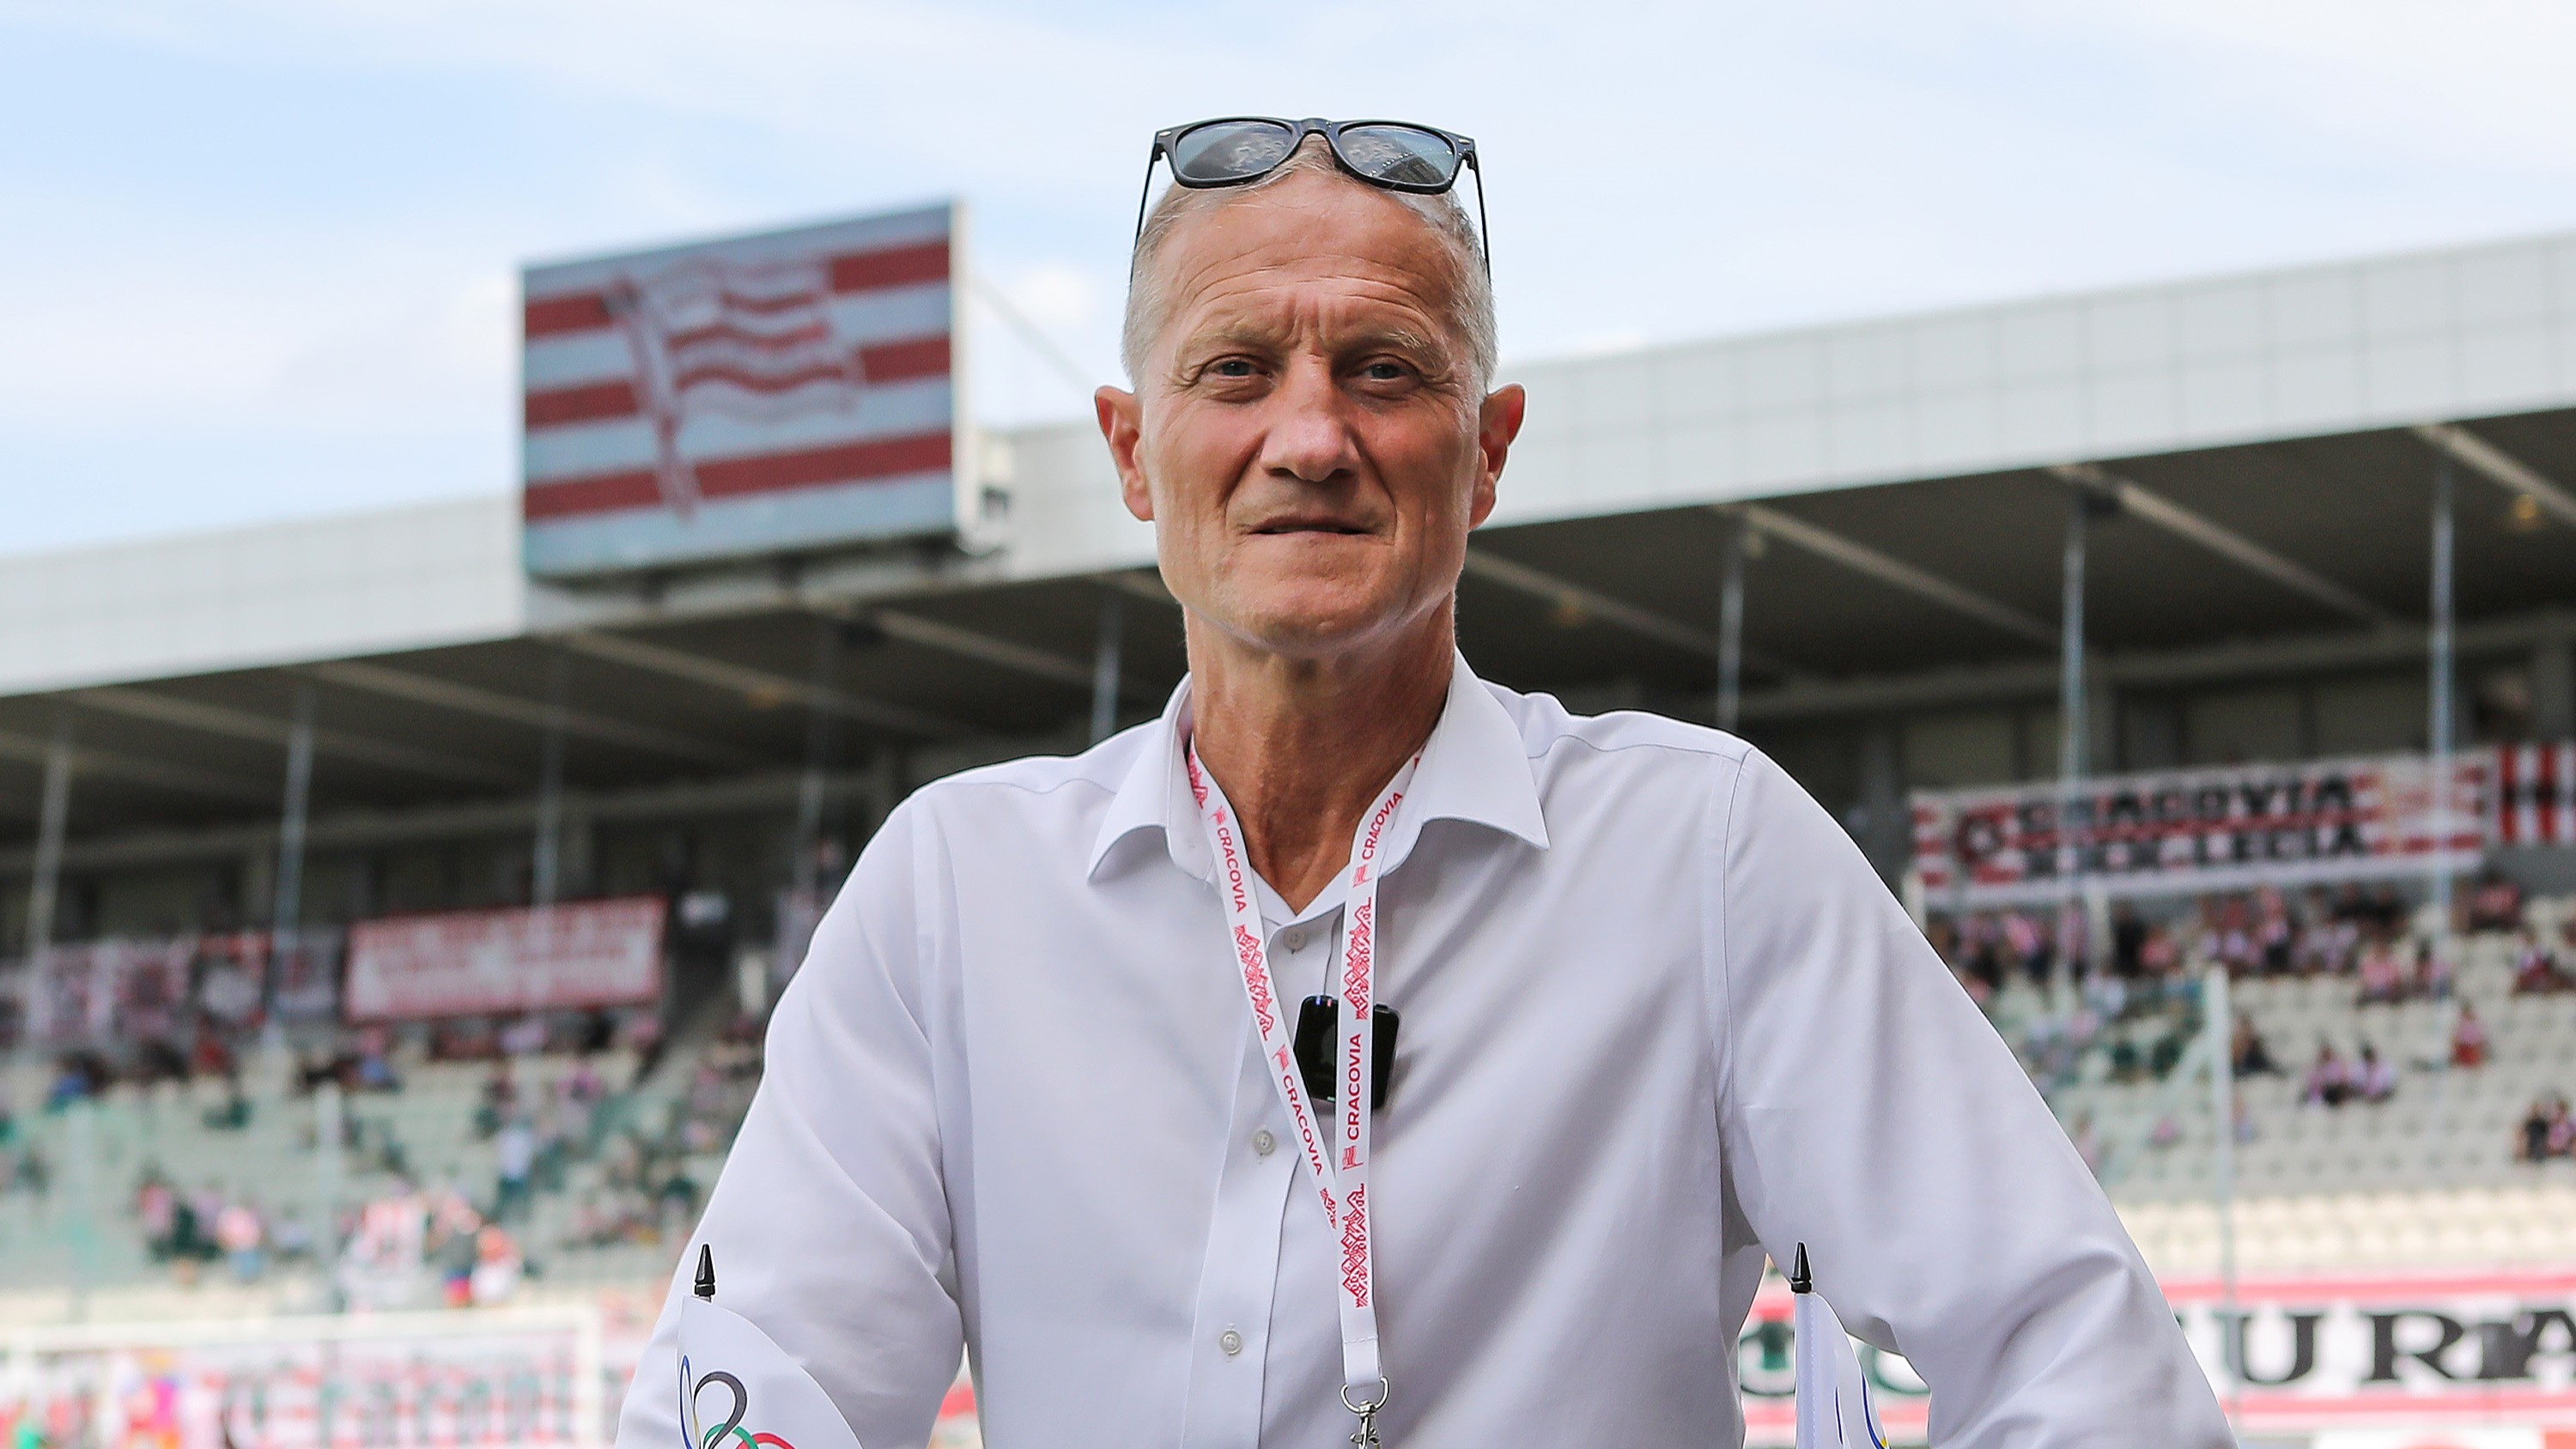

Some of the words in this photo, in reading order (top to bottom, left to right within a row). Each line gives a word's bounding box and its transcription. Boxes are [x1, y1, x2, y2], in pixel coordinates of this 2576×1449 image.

[1362, 791, 1403, 861] CRACOVIA
[2020, 774, 2354, 828] CRACOVIA
[1217, 827, 1249, 913] CRACOVIA
[1283, 1075, 1322, 1176] CRACOVIA
[1347, 1033, 1362, 1141] CRACOVIA
[2175, 1308, 2576, 1384] URA
